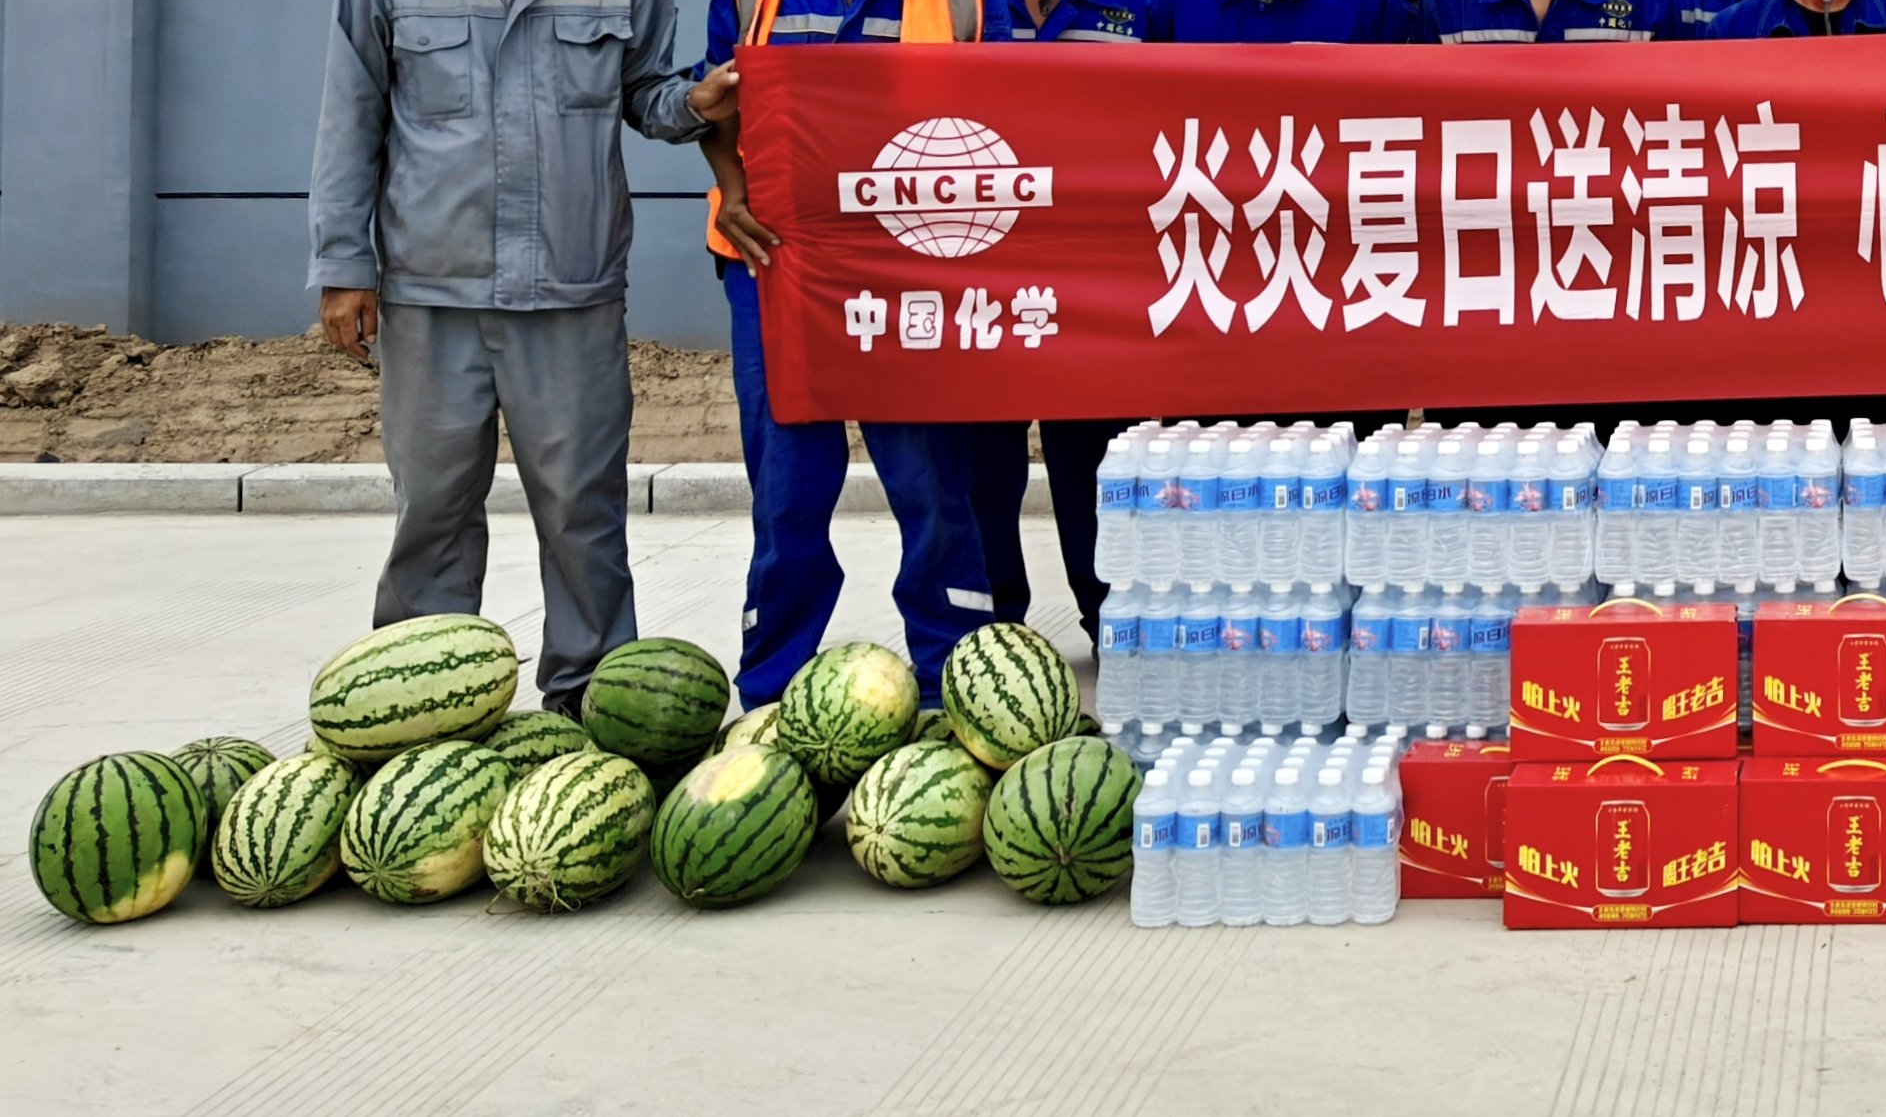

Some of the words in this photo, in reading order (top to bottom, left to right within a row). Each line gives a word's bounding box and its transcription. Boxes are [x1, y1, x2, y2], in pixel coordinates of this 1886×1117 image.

[855, 173, 1036, 208] CNCEC
[1147, 100, 1805, 337] 炎炎夏日送清凉
[844, 285, 1059, 352] 中国化学
[1522, 680, 1581, 723] 怕上火
[1614, 656, 1633, 716] 王老吉
[1662, 676, 1725, 721] 喝王老吉
[1763, 675, 1822, 718] 怕上火
[1855, 652, 1873, 712] 王老吉
[1411, 818, 1468, 860] 怕上火
[1613, 820, 1632, 882] 王老吉
[1750, 838, 1810, 883] 怕上火
[1844, 815, 1863, 878] 王老吉
[1518, 844, 1579, 889] 怕上火
[1662, 841, 1726, 887] 喝王老吉
